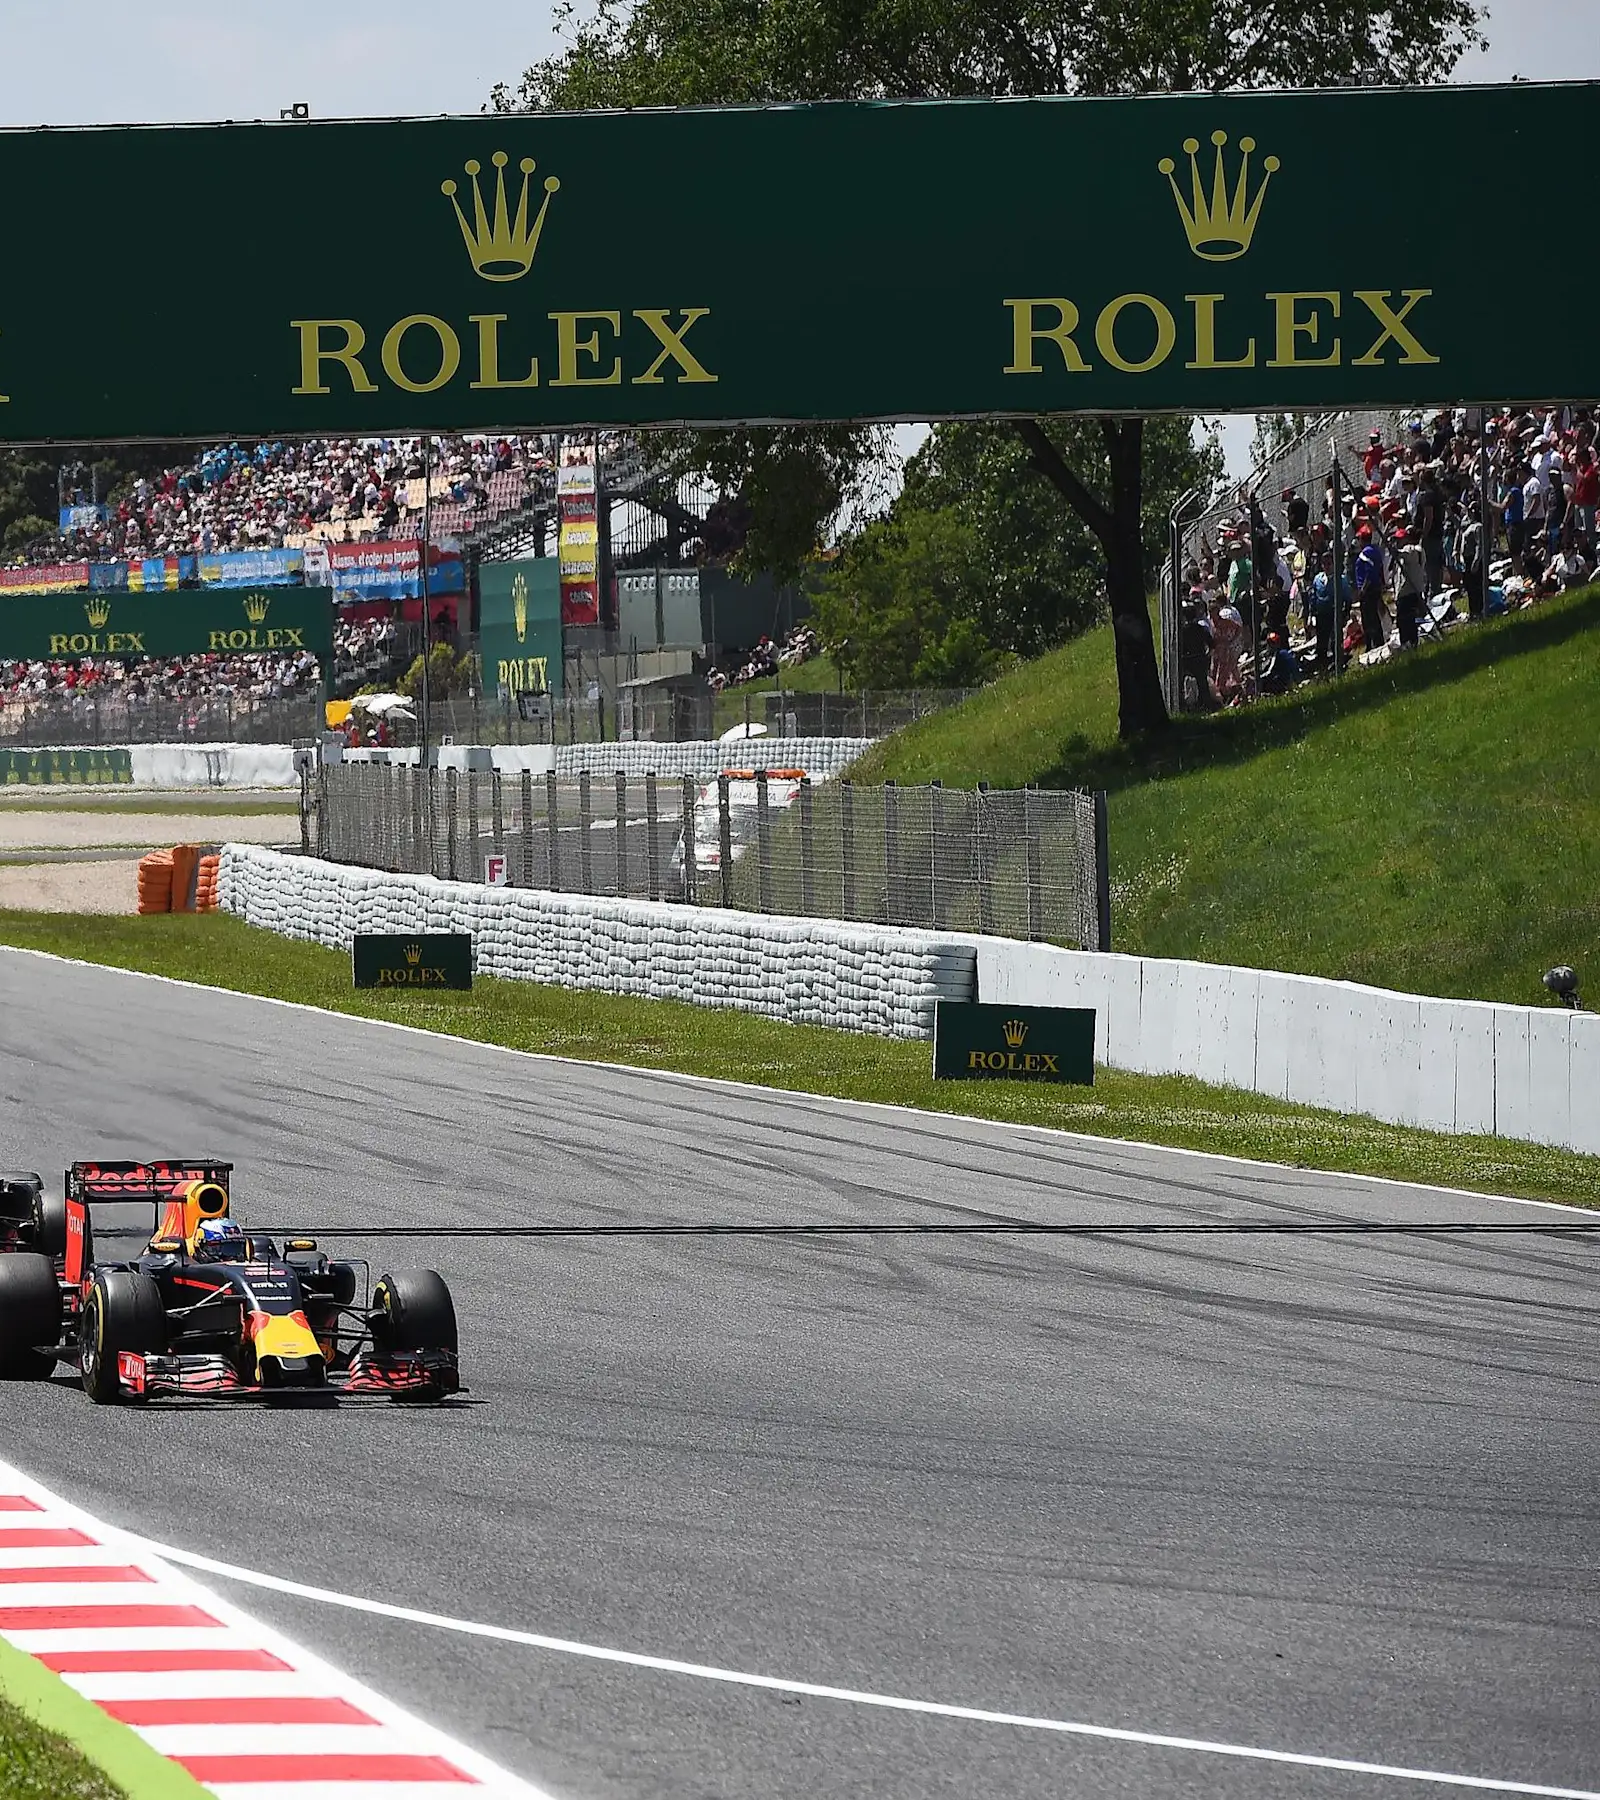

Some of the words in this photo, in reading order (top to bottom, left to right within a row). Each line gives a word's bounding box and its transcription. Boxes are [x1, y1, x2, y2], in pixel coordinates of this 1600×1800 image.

[1004, 290, 1438, 373] ROLEX
[292, 308, 717, 393] ROLEX
[50, 632, 145, 654] ROLEX
[208, 628, 304, 650] ROLEX
[488, 858, 504, 883] F
[379, 967, 447, 982] ROLEX
[967, 1051, 1060, 1073] ROLEX
